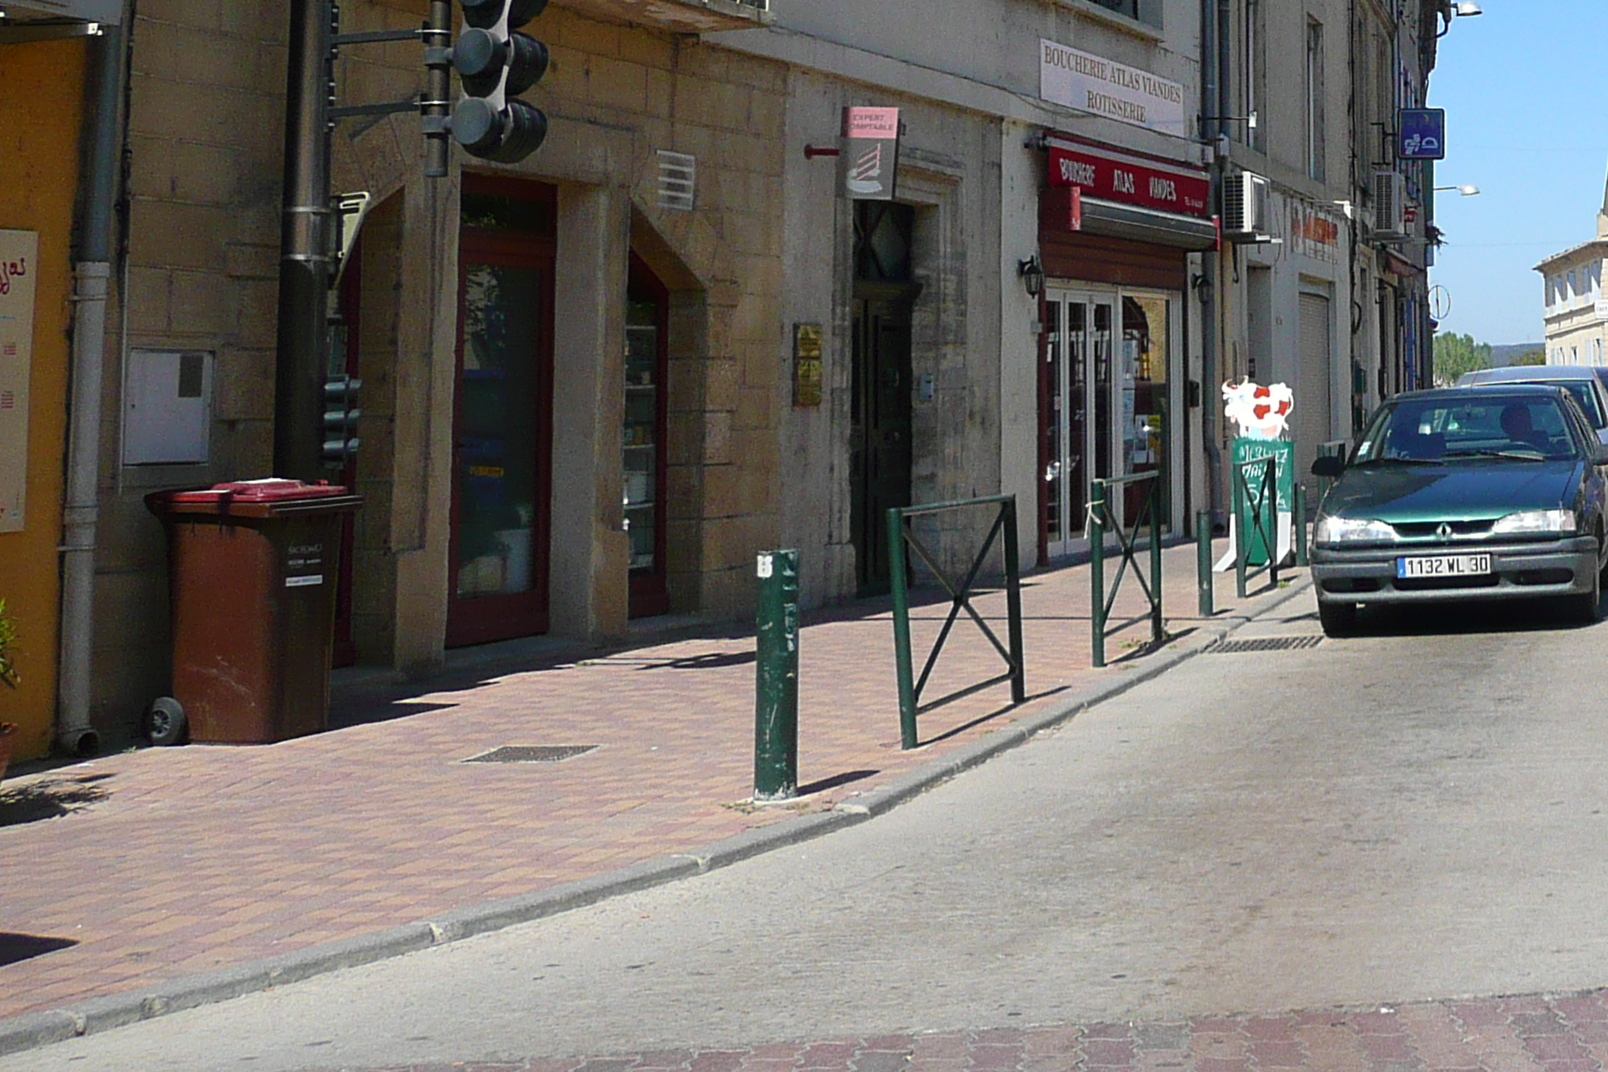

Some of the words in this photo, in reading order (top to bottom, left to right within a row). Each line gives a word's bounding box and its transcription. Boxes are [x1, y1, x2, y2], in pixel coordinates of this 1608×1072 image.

[1044, 45, 1107, 80] BOUCHERIE
[1109, 64, 1140, 91] ATLAS
[1141, 75, 1181, 104] VIANDES
[1086, 89, 1146, 123] ROTISSERIE
[849, 123, 894, 132] OMPTABLE
[1113, 169, 1135, 194] ATLAS
[1149, 176, 1177, 202] VIANDES
[1408, 558, 1443, 575] 1132
[1446, 557, 1465, 574] WL
[1469, 556, 1488, 572] 30
